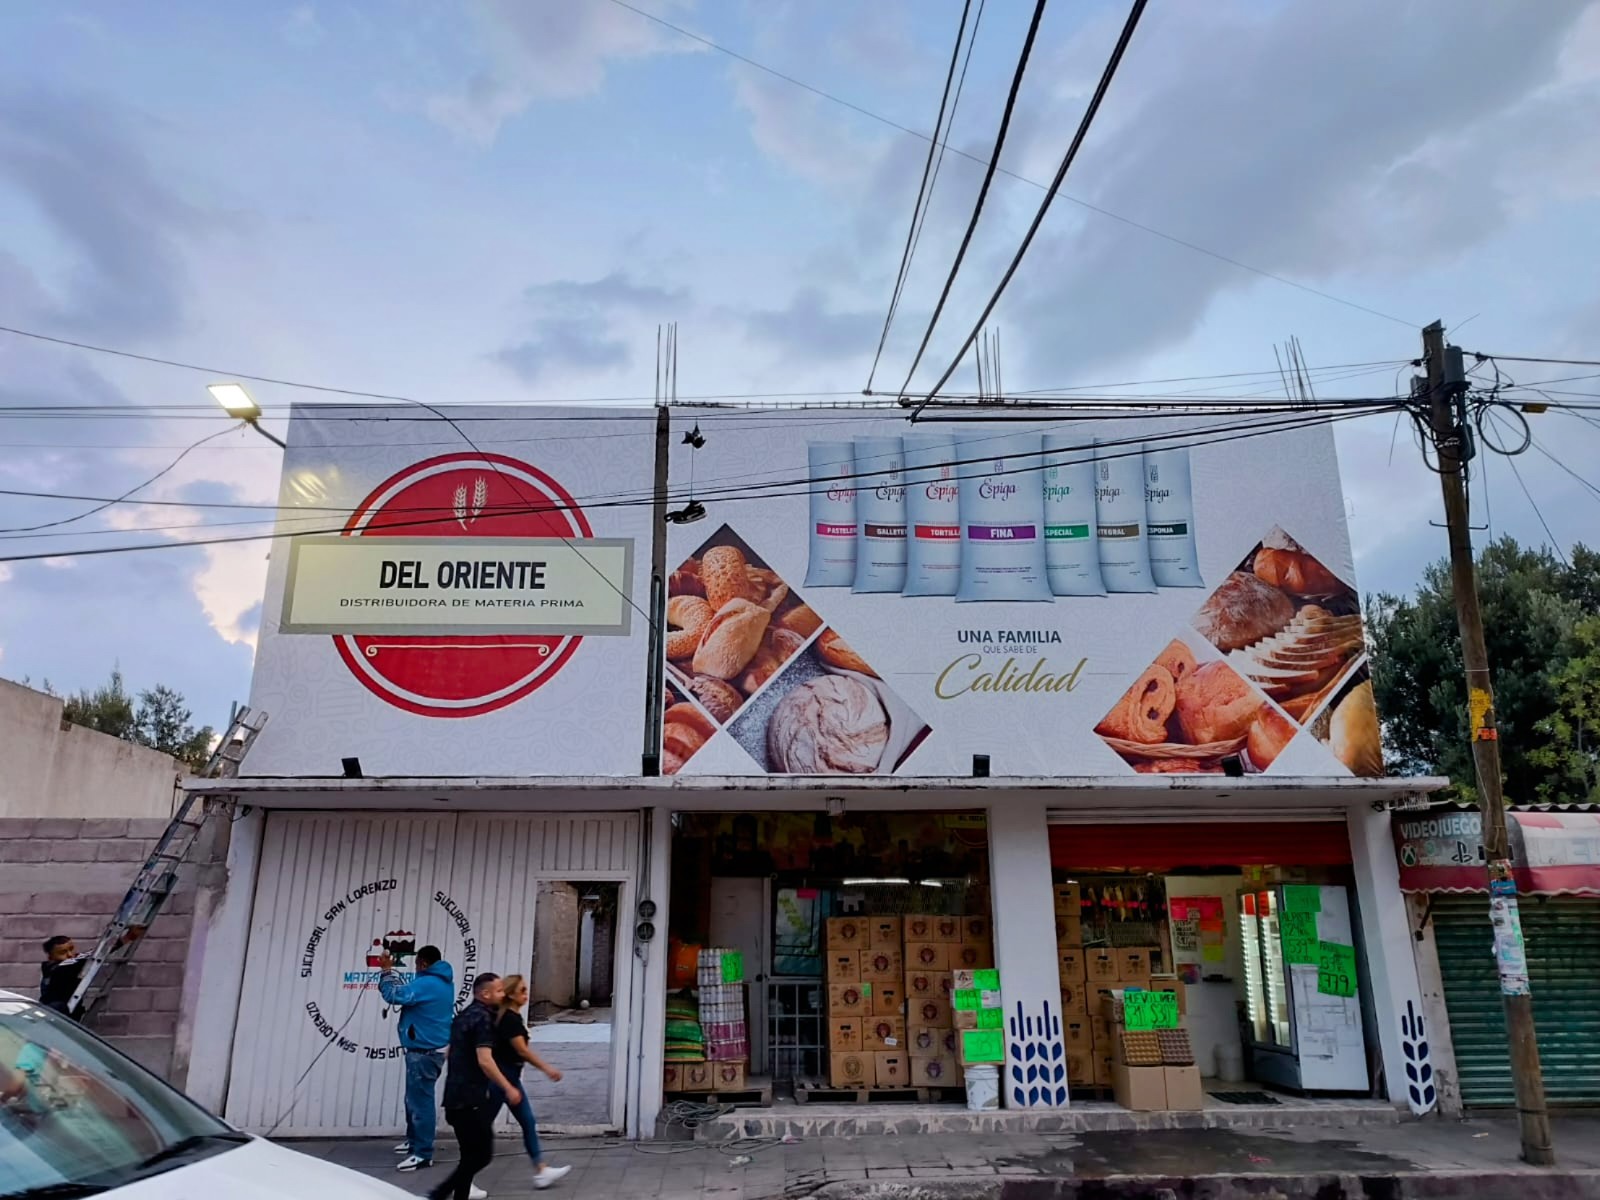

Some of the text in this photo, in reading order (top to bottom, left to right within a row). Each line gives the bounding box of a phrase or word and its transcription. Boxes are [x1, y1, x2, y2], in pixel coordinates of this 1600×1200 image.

[979, 477, 1016, 501] Espiga
[1094, 480, 1120, 503] spiga
[990, 528, 1014, 539] FINA
[1045, 528, 1073, 537] SPECIAL
[379, 560, 547, 590] DEL ORIENTE
[339, 597, 584, 608] DISTRIBUIDORA DE MATERIA PRIMA
[957, 629, 1062, 644] UNA FAMILIA
[983, 645, 1038, 655] QUE SABE DE
[934, 653, 1088, 700] Calidad
[1400, 817, 1482, 840] VIDEOJUEGO
[301, 878, 397, 978] SUCURSAL SAN LORENZO
[433, 891, 477, 1016] SUCURSAL SAN LORENZ
[305, 1001, 339, 1043] LORENZO
[336, 1037, 359, 1054] SAN
